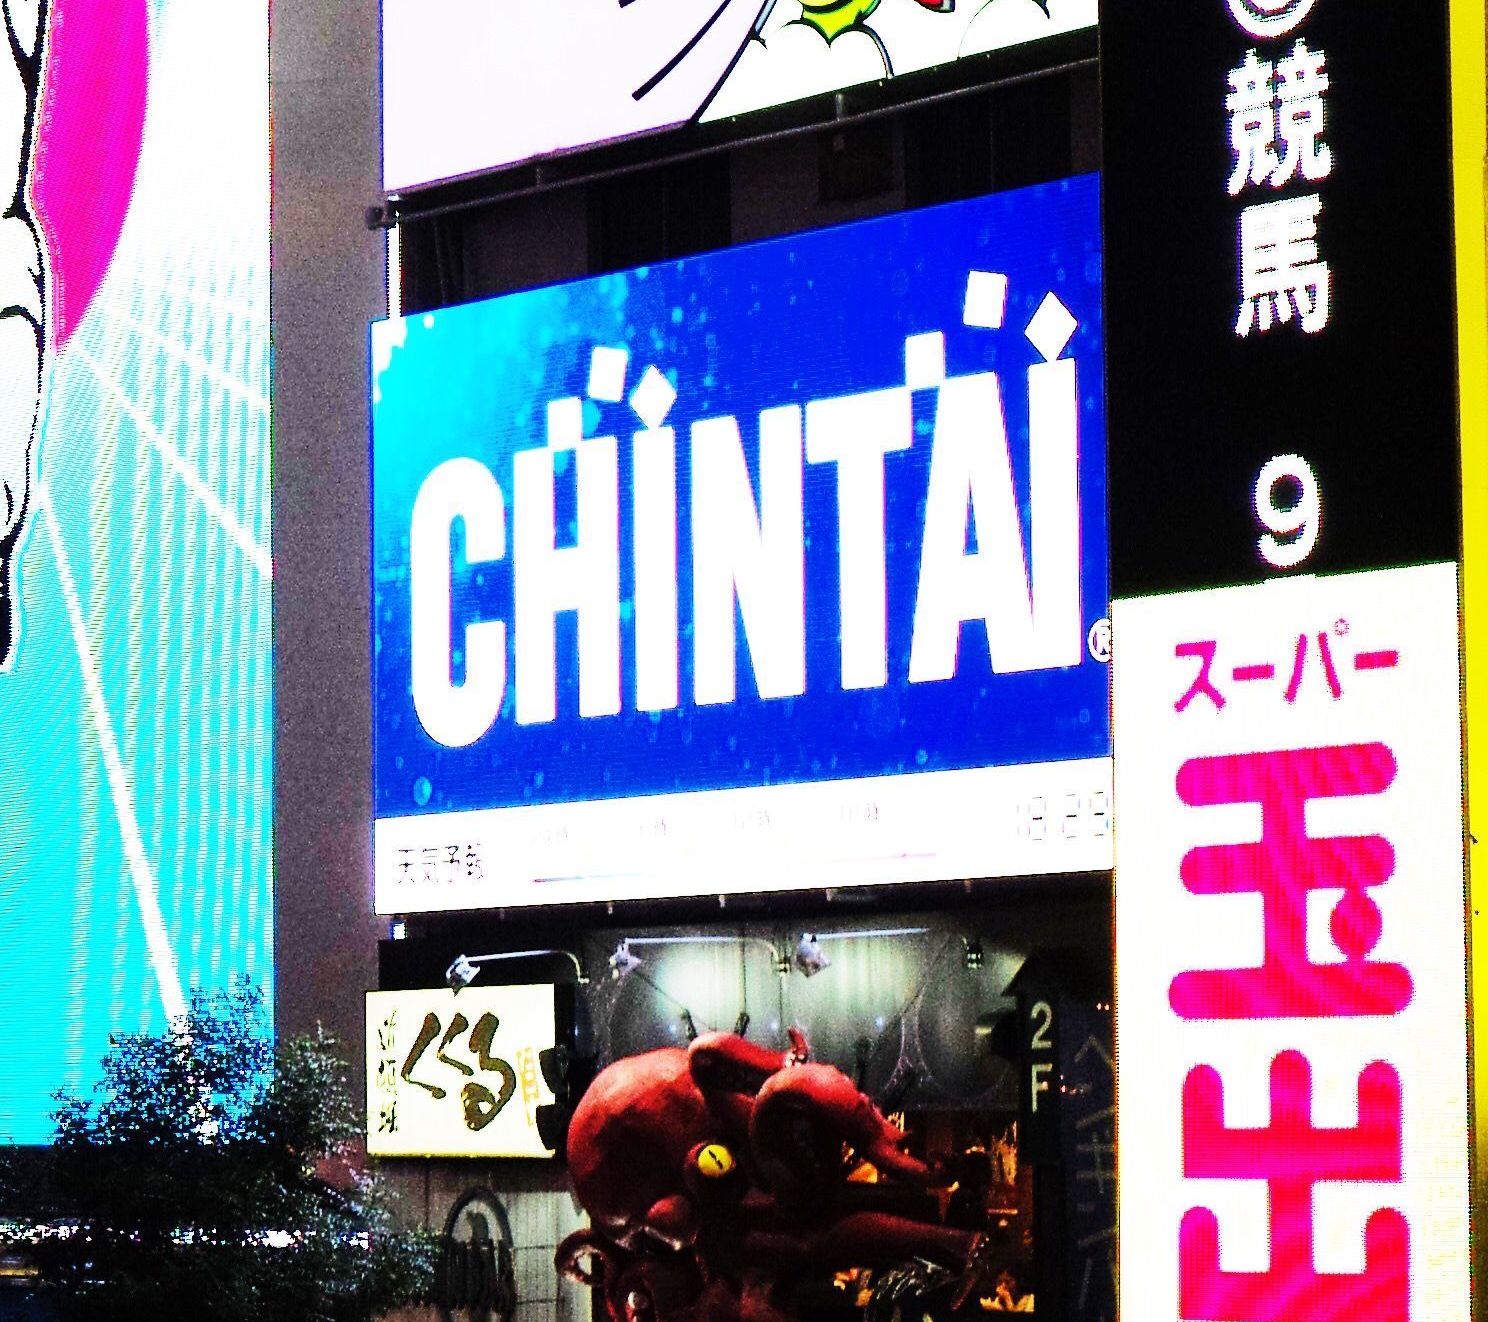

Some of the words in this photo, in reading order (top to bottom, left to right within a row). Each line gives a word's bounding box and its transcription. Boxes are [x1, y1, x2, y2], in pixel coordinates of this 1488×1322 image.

[1174, 618, 1401, 715] スーパー
[401, 1011, 517, 1132] くくる
